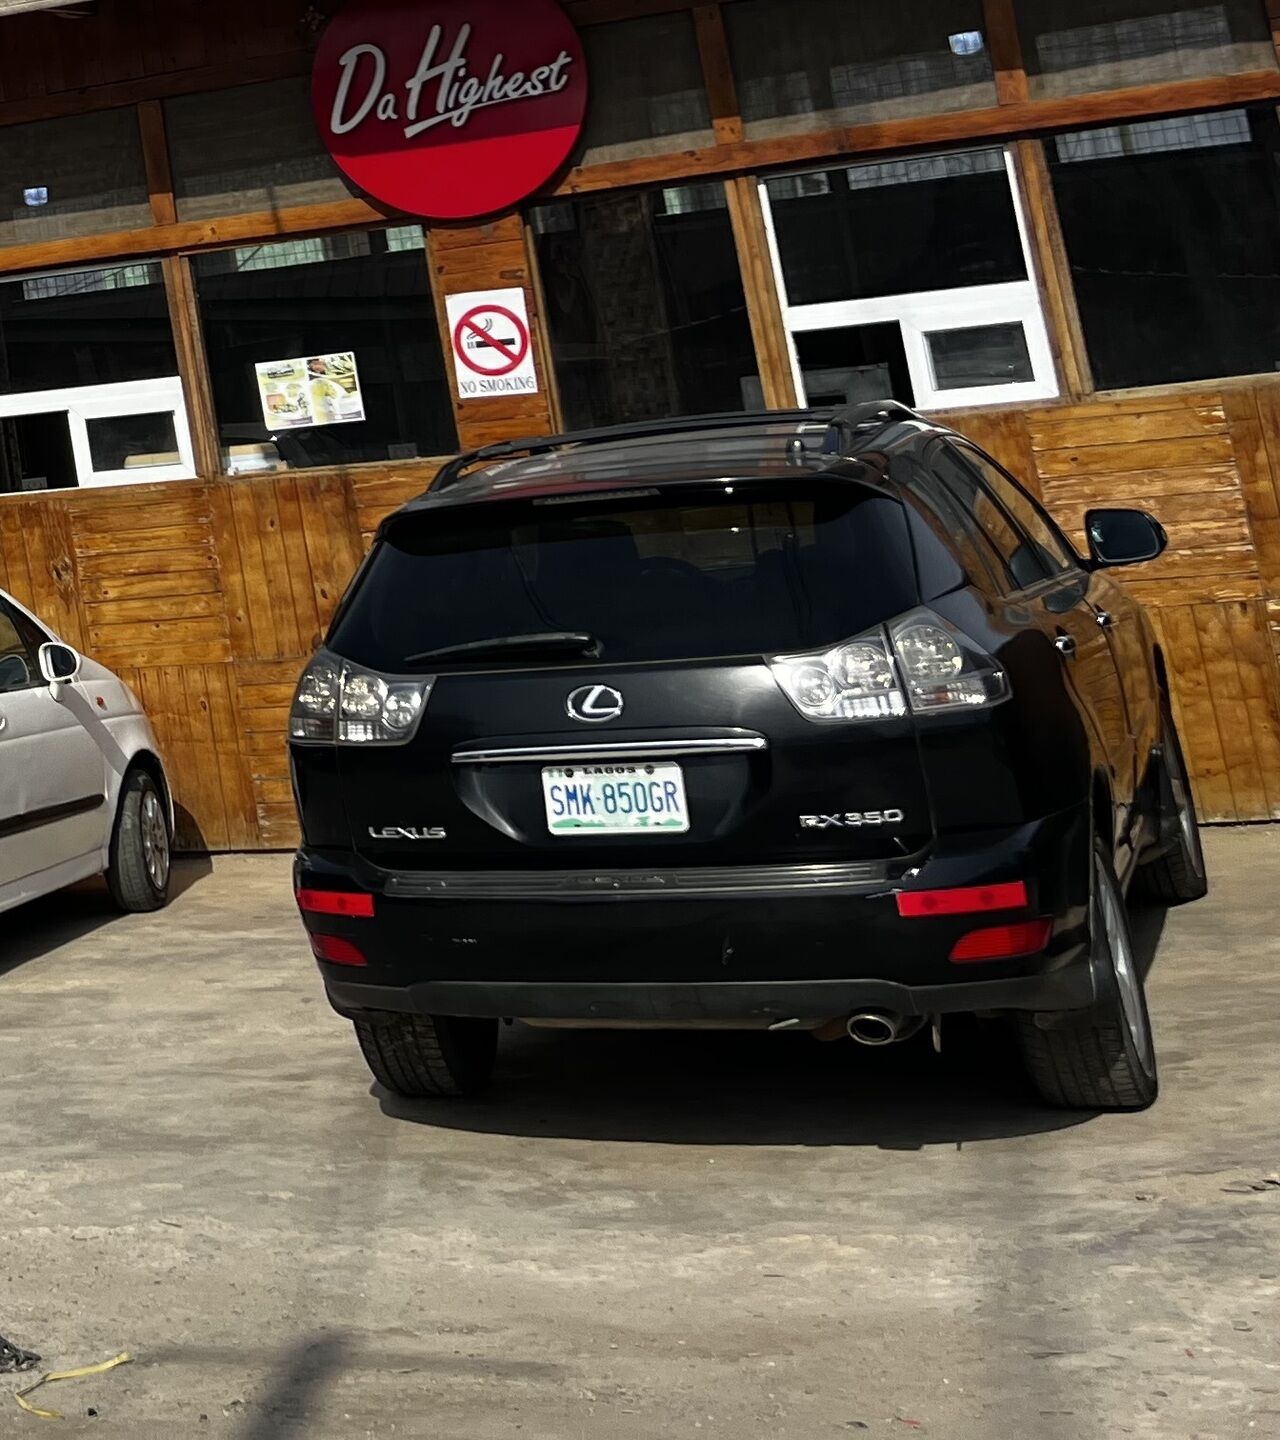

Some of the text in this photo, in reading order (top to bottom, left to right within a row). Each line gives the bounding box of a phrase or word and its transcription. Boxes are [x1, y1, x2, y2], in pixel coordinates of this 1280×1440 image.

[331, 23, 573, 134] Da Highest
[460, 375, 535, 394] NO SMOKING
[582, 766, 637, 775] LAGOS
[368, 826, 447, 840] LEXUS
